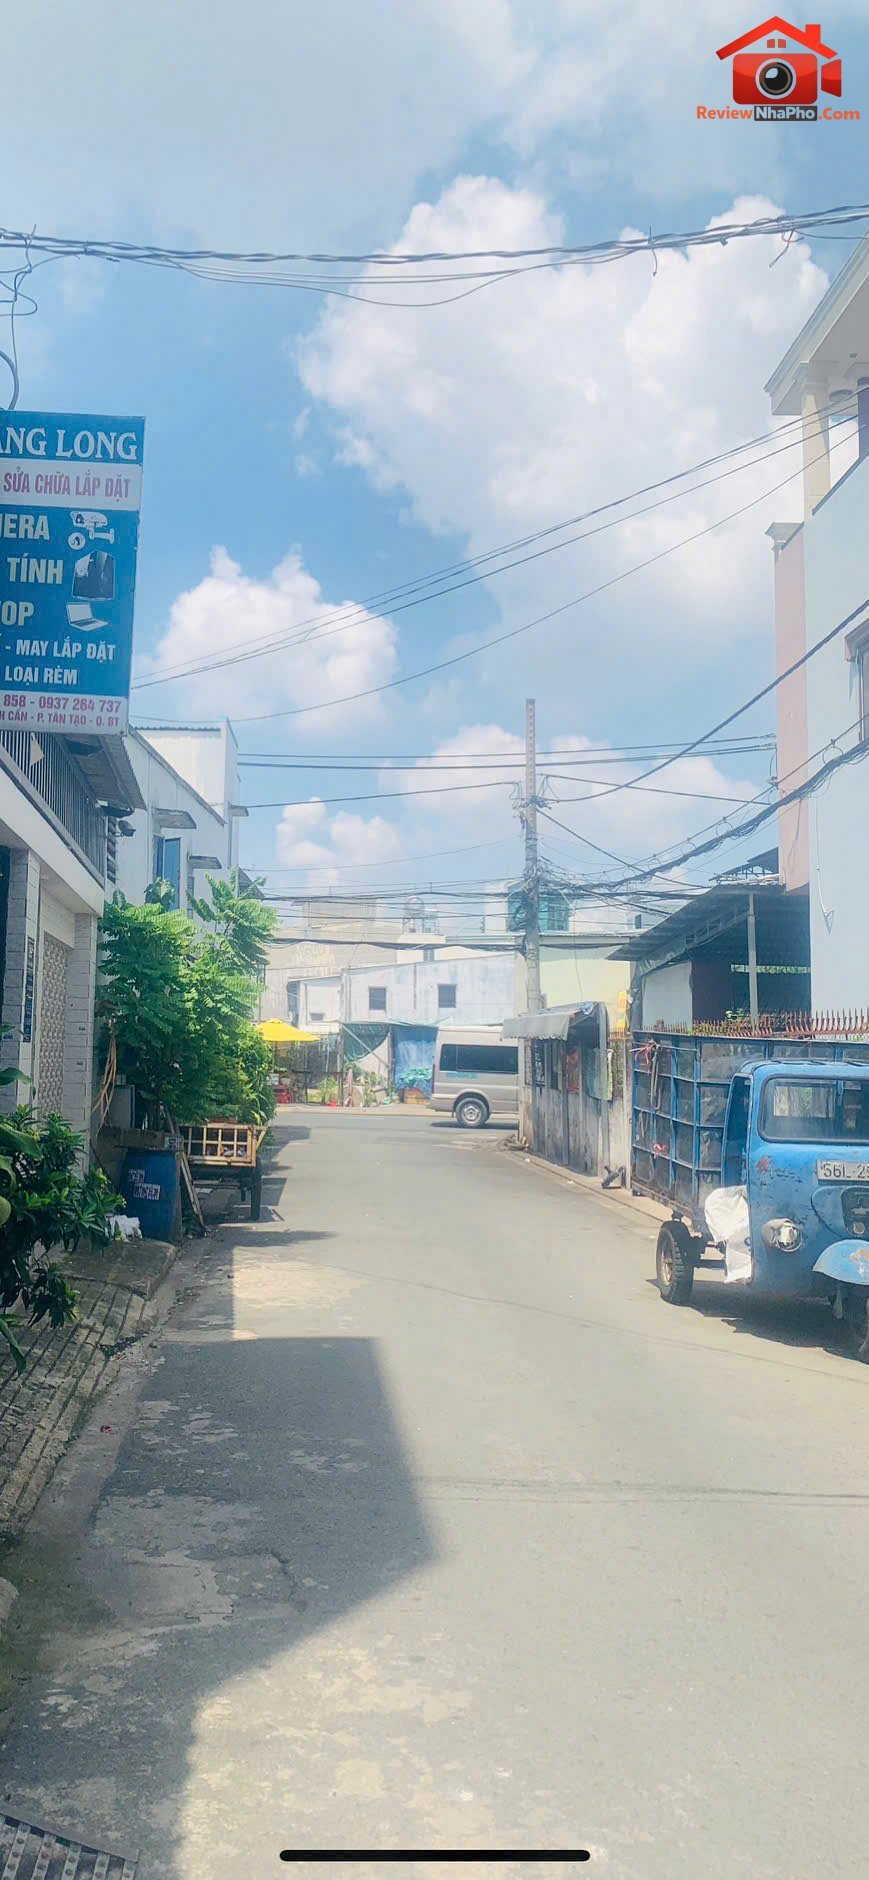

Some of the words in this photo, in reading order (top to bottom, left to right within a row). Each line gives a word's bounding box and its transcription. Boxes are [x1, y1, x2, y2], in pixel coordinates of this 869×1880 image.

[55, 429, 138, 460] LONG
[3, 466, 30, 493] SỬA
[34, 471, 71, 496] CHỮA
[75, 469, 101, 497] LẮP
[104, 474, 131, 502] ĐẶT
[7, 553, 64, 585] TÍNH
[0, 600, 35, 626] OP
[16, 639, 49, 657] MAY
[53, 636, 82, 659] LẮP
[86, 641, 116, 663] ĐẶT
[4, 665, 39, 685] LOẠI
[3, 694, 27, 708] 858
[38, 696, 69, 711] 0937
[72, 698, 95, 712] 264
[98, 700, 122, 713] 737
[48, 712, 66, 724] TÂN
[69, 714, 87, 727] TẠO
